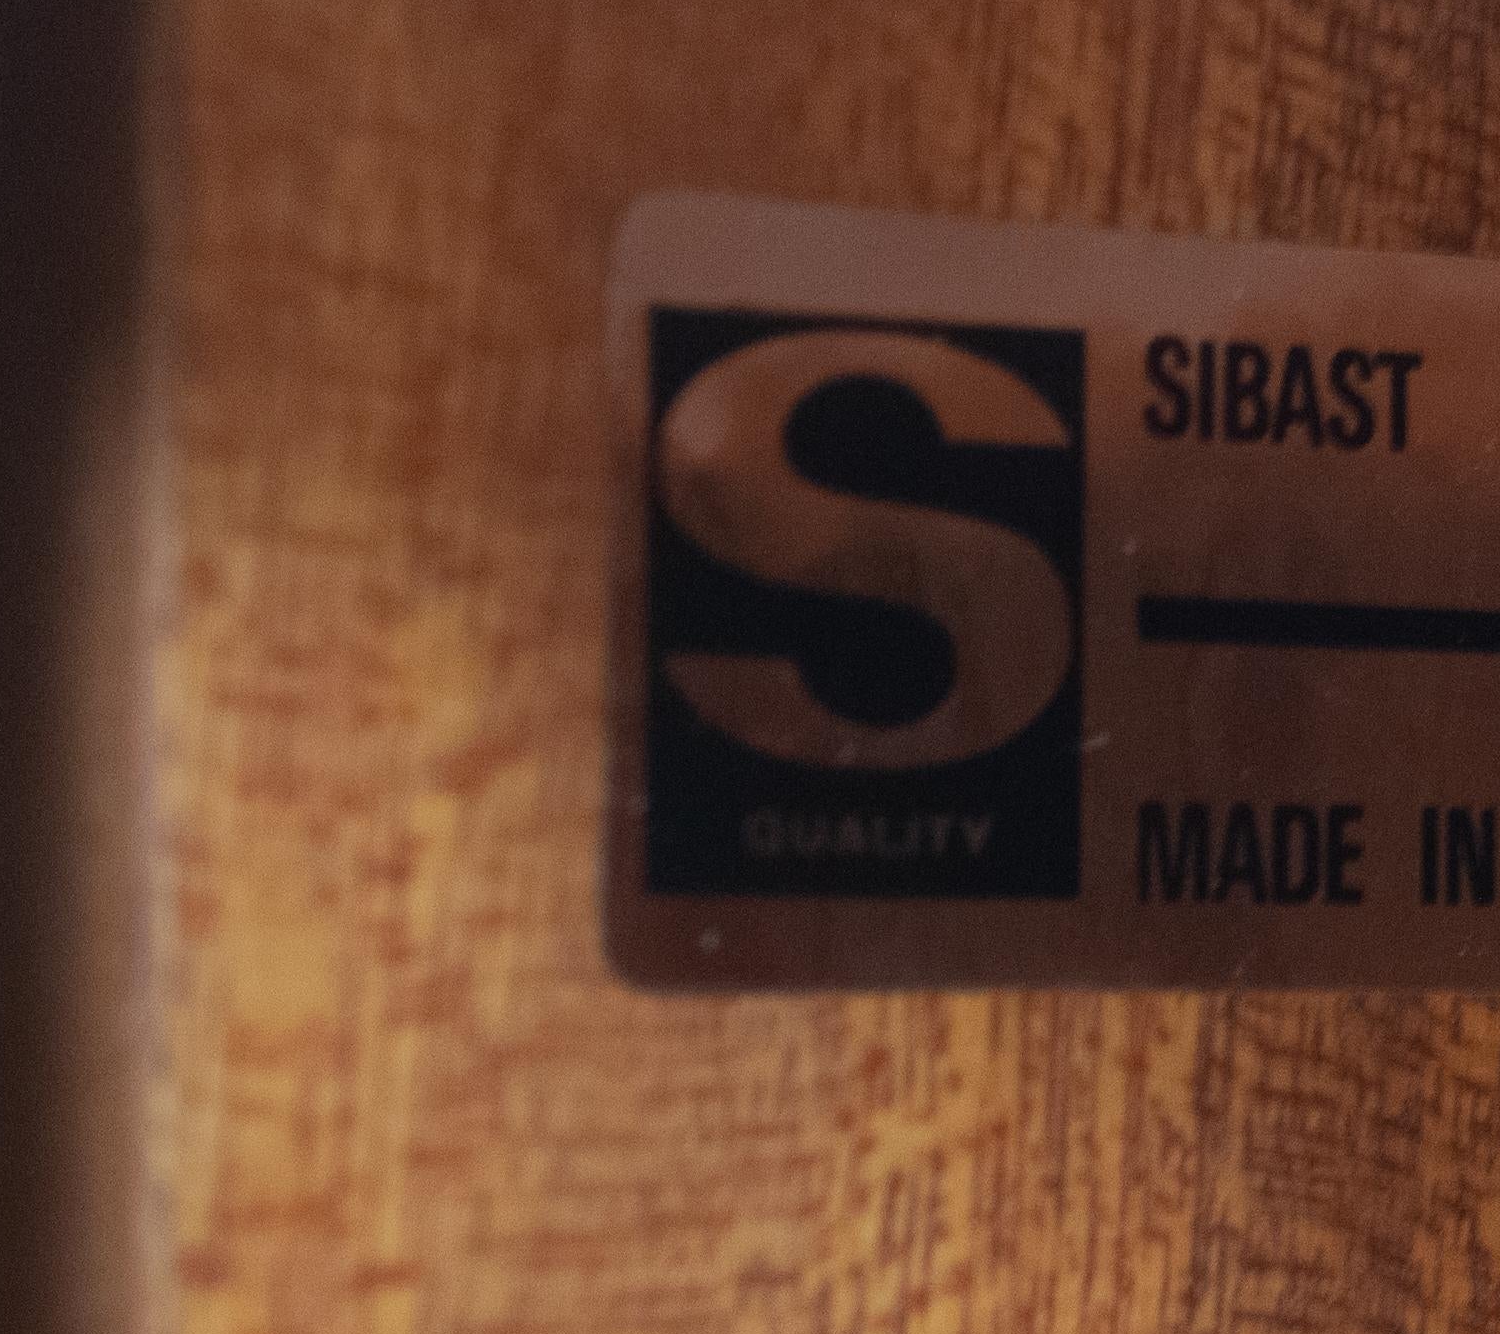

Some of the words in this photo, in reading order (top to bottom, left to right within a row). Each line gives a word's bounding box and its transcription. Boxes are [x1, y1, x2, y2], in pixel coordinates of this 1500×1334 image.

[1143, 334, 1424, 453] SIBAST
[658, 328, 1072, 767] S
[741, 810, 994, 858] QUALITY
[1136, 800, 1366, 907] MADE
[1419, 805, 1497, 907] IN
